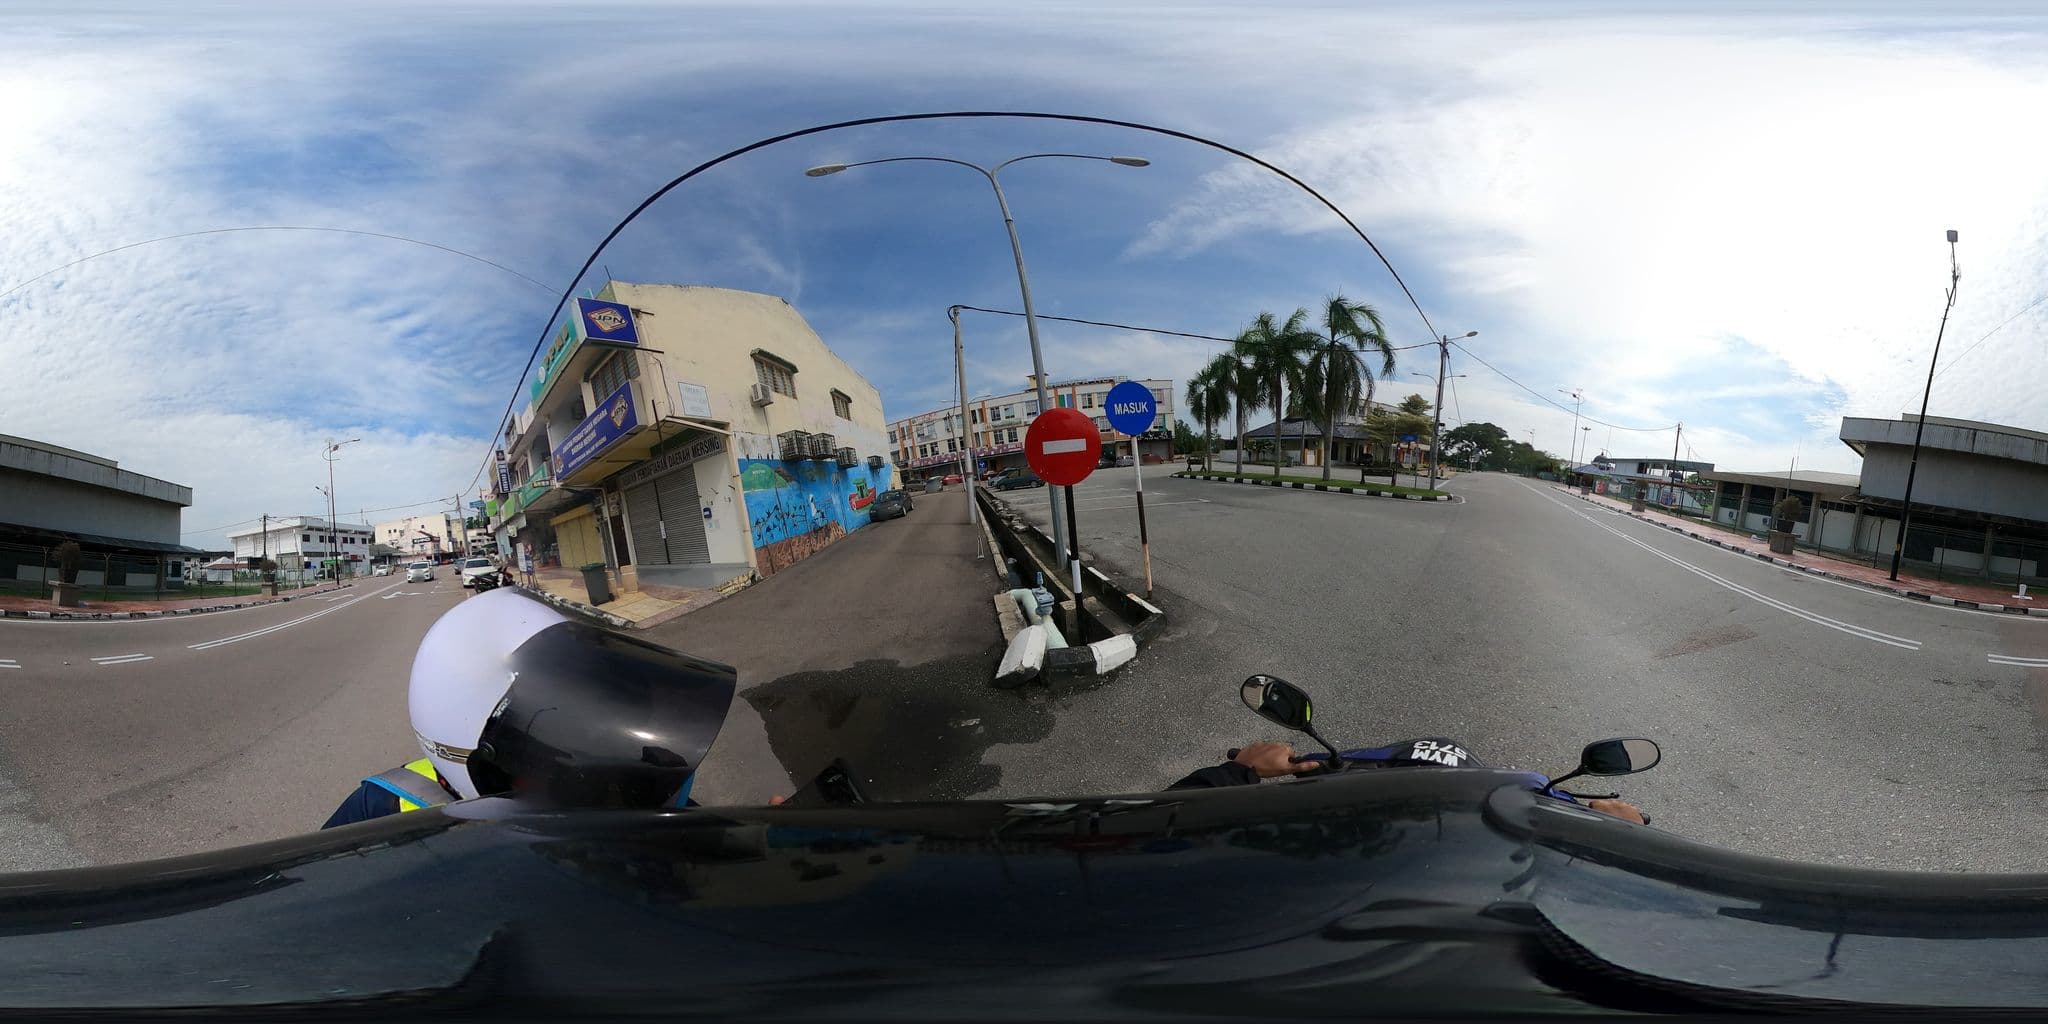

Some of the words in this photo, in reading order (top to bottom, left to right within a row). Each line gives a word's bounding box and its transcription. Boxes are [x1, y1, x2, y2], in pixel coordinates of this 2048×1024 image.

[596, 314, 623, 325] JPN
[1114, 402, 1148, 415] MASUK
[668, 448, 691, 468] DAERAH
[692, 436, 720, 459] MERSING
[1411, 749, 1458, 767] WYM
[1413, 740, 1467, 760] 5713
